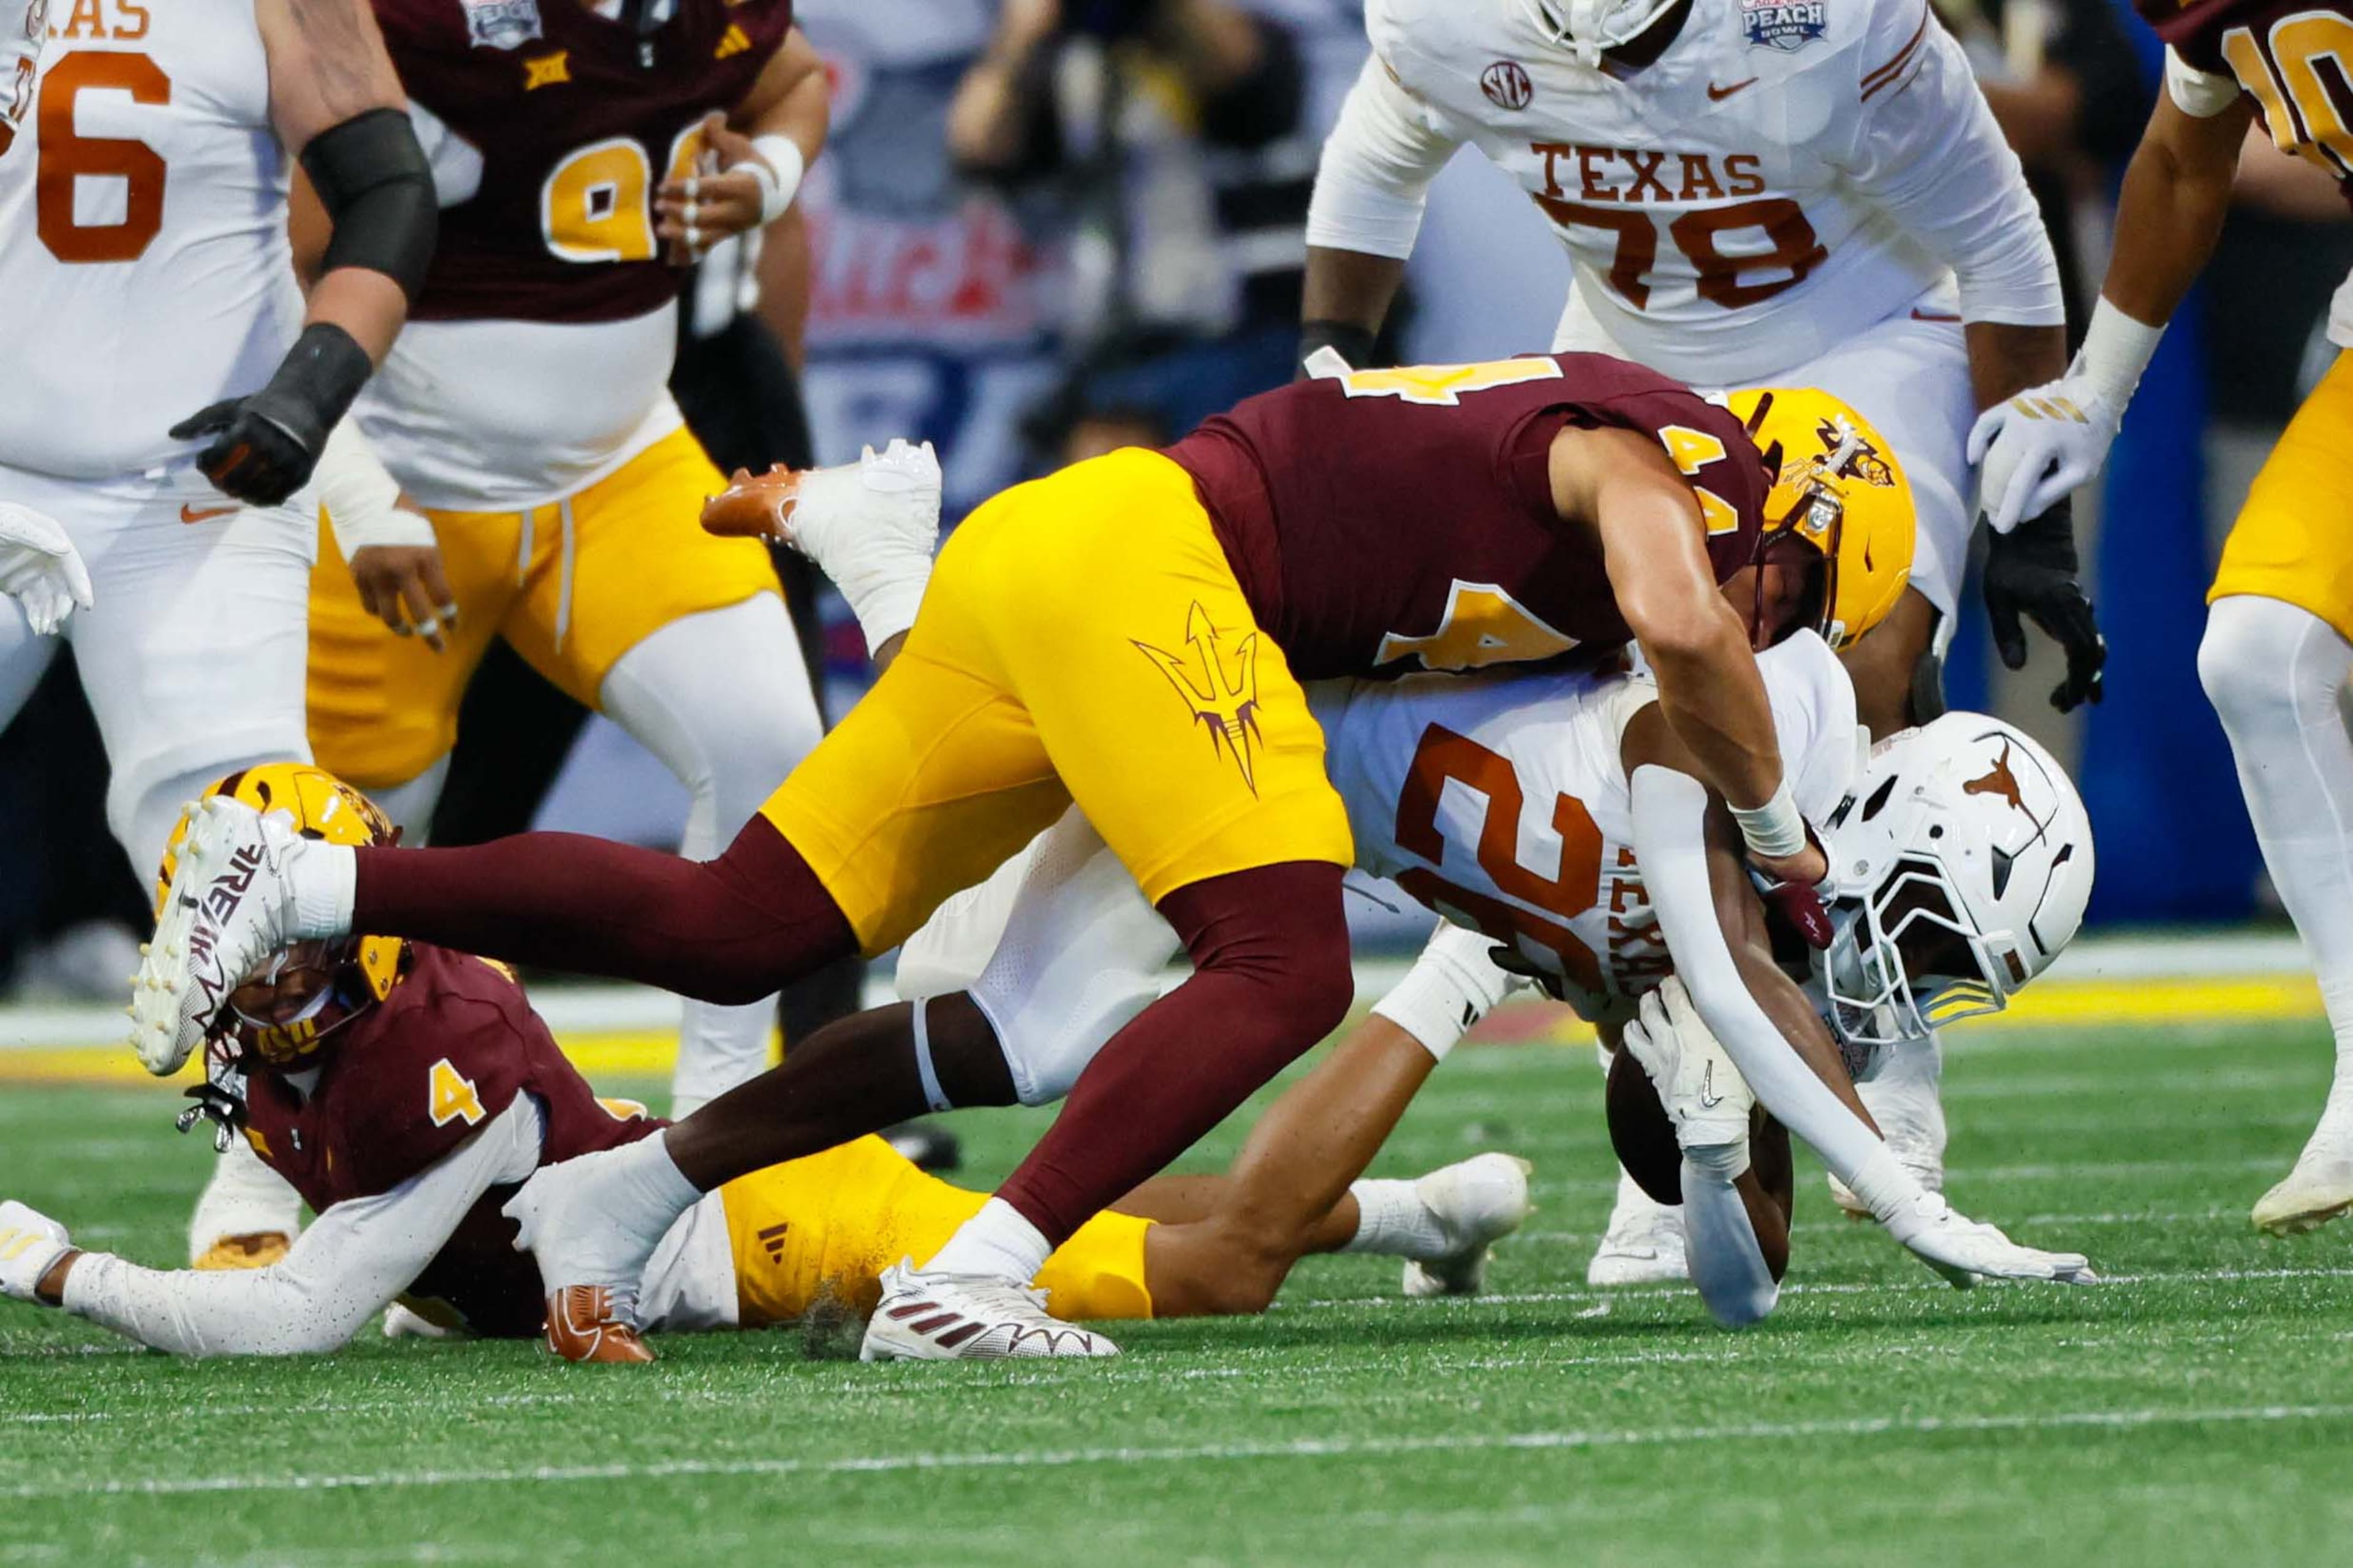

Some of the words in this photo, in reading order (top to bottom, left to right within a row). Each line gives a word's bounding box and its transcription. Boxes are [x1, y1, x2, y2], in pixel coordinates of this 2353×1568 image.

[48, 0, 150, 40] AS
[1743, 4, 1824, 34] PEACH
[1760, 26, 1809, 39] BOWL
[1482, 64, 1529, 107] SEC
[2221, 9, 2353, 178] 10
[1531, 142, 1766, 203] TEXAS
[1533, 191, 1828, 311] 78
[1608, 847, 1675, 997] EXA
[429, 1058, 487, 1127] 4
